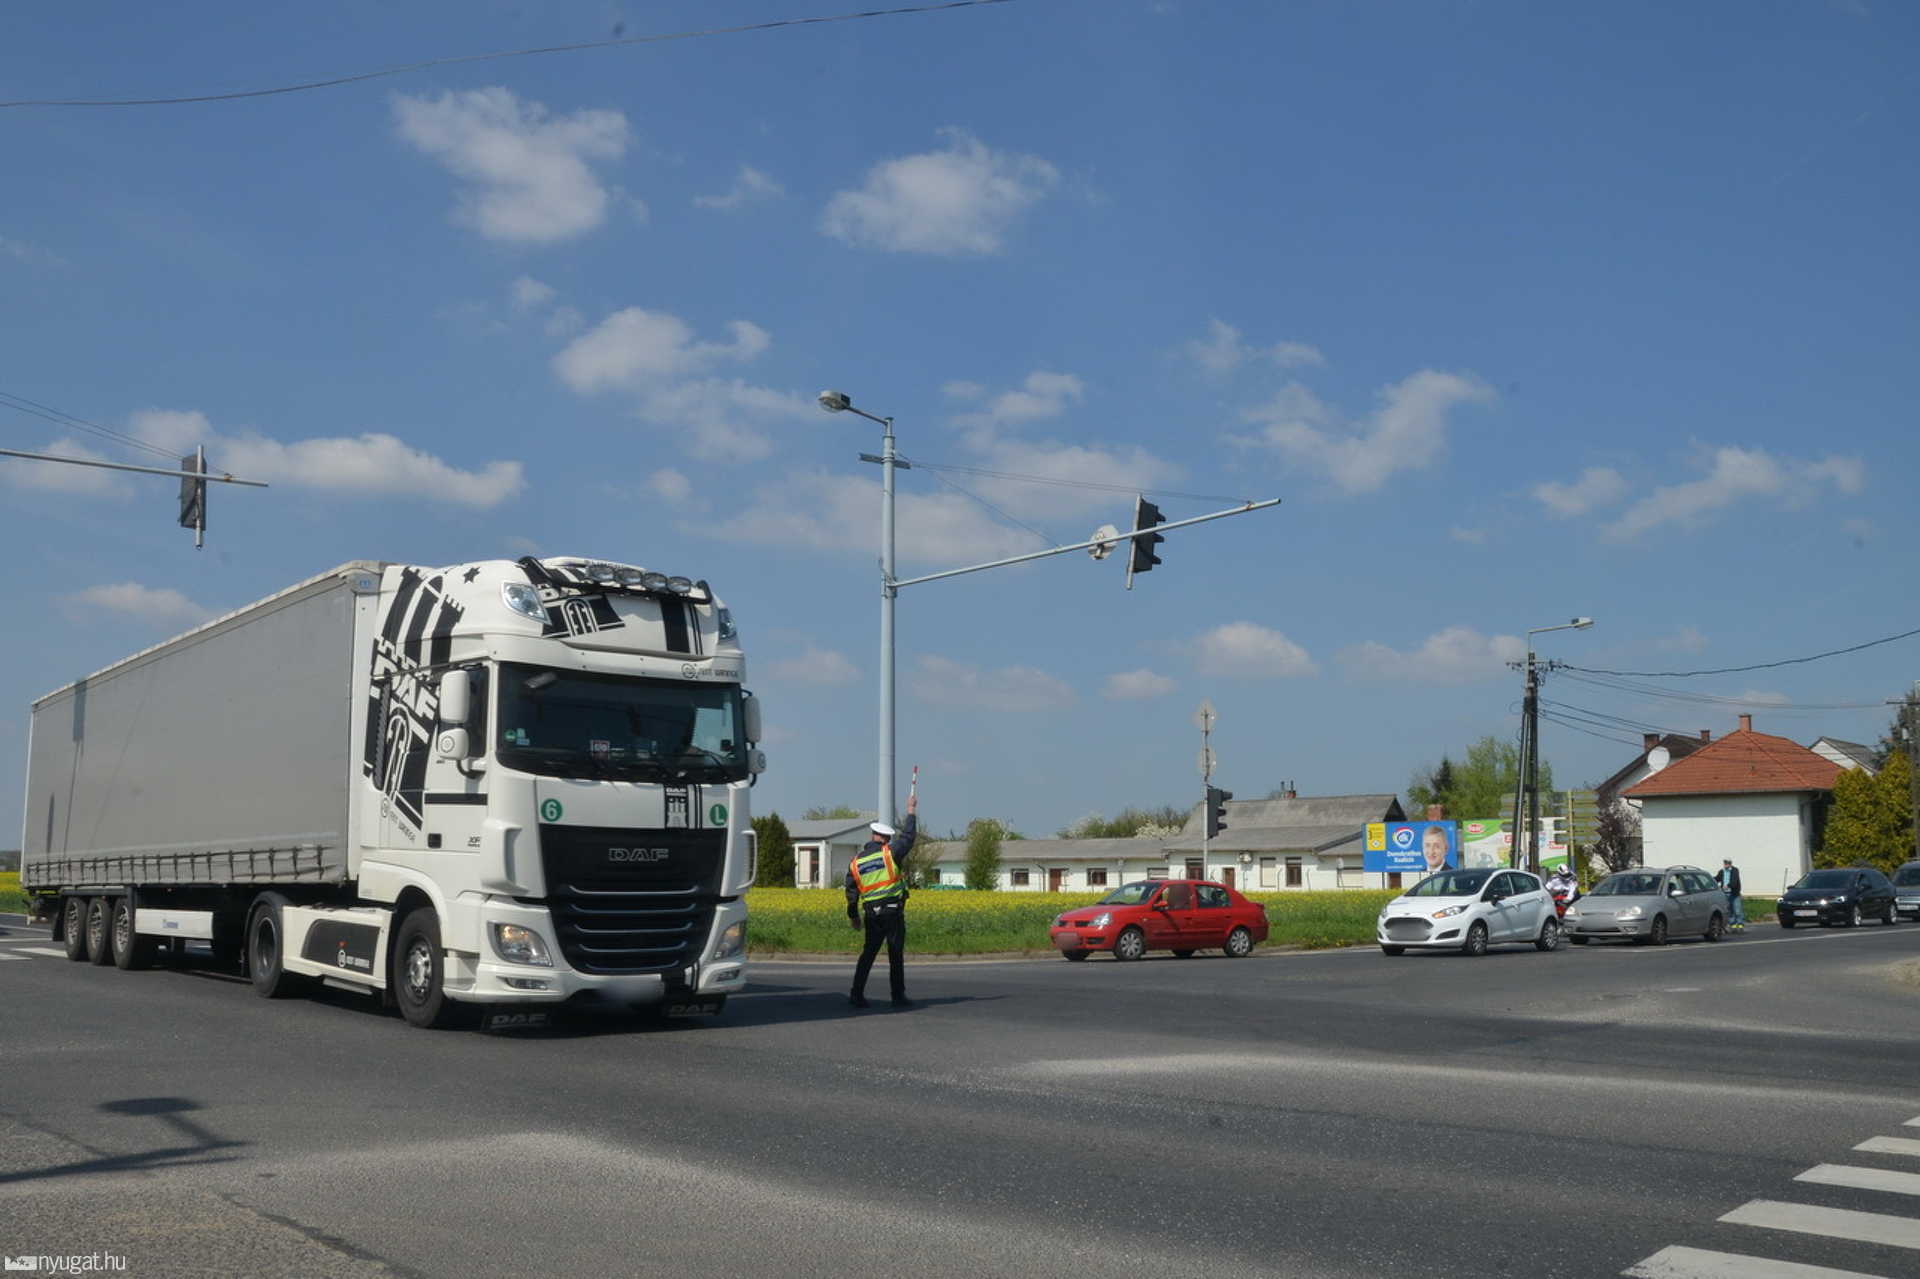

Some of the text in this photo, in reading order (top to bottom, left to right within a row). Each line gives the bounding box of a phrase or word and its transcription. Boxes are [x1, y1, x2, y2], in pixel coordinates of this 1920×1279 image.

[544, 801, 558, 820] 6
[714, 806, 725, 825] L
[608, 848, 669, 862] DAF
[491, 1014, 547, 1025] DAF
